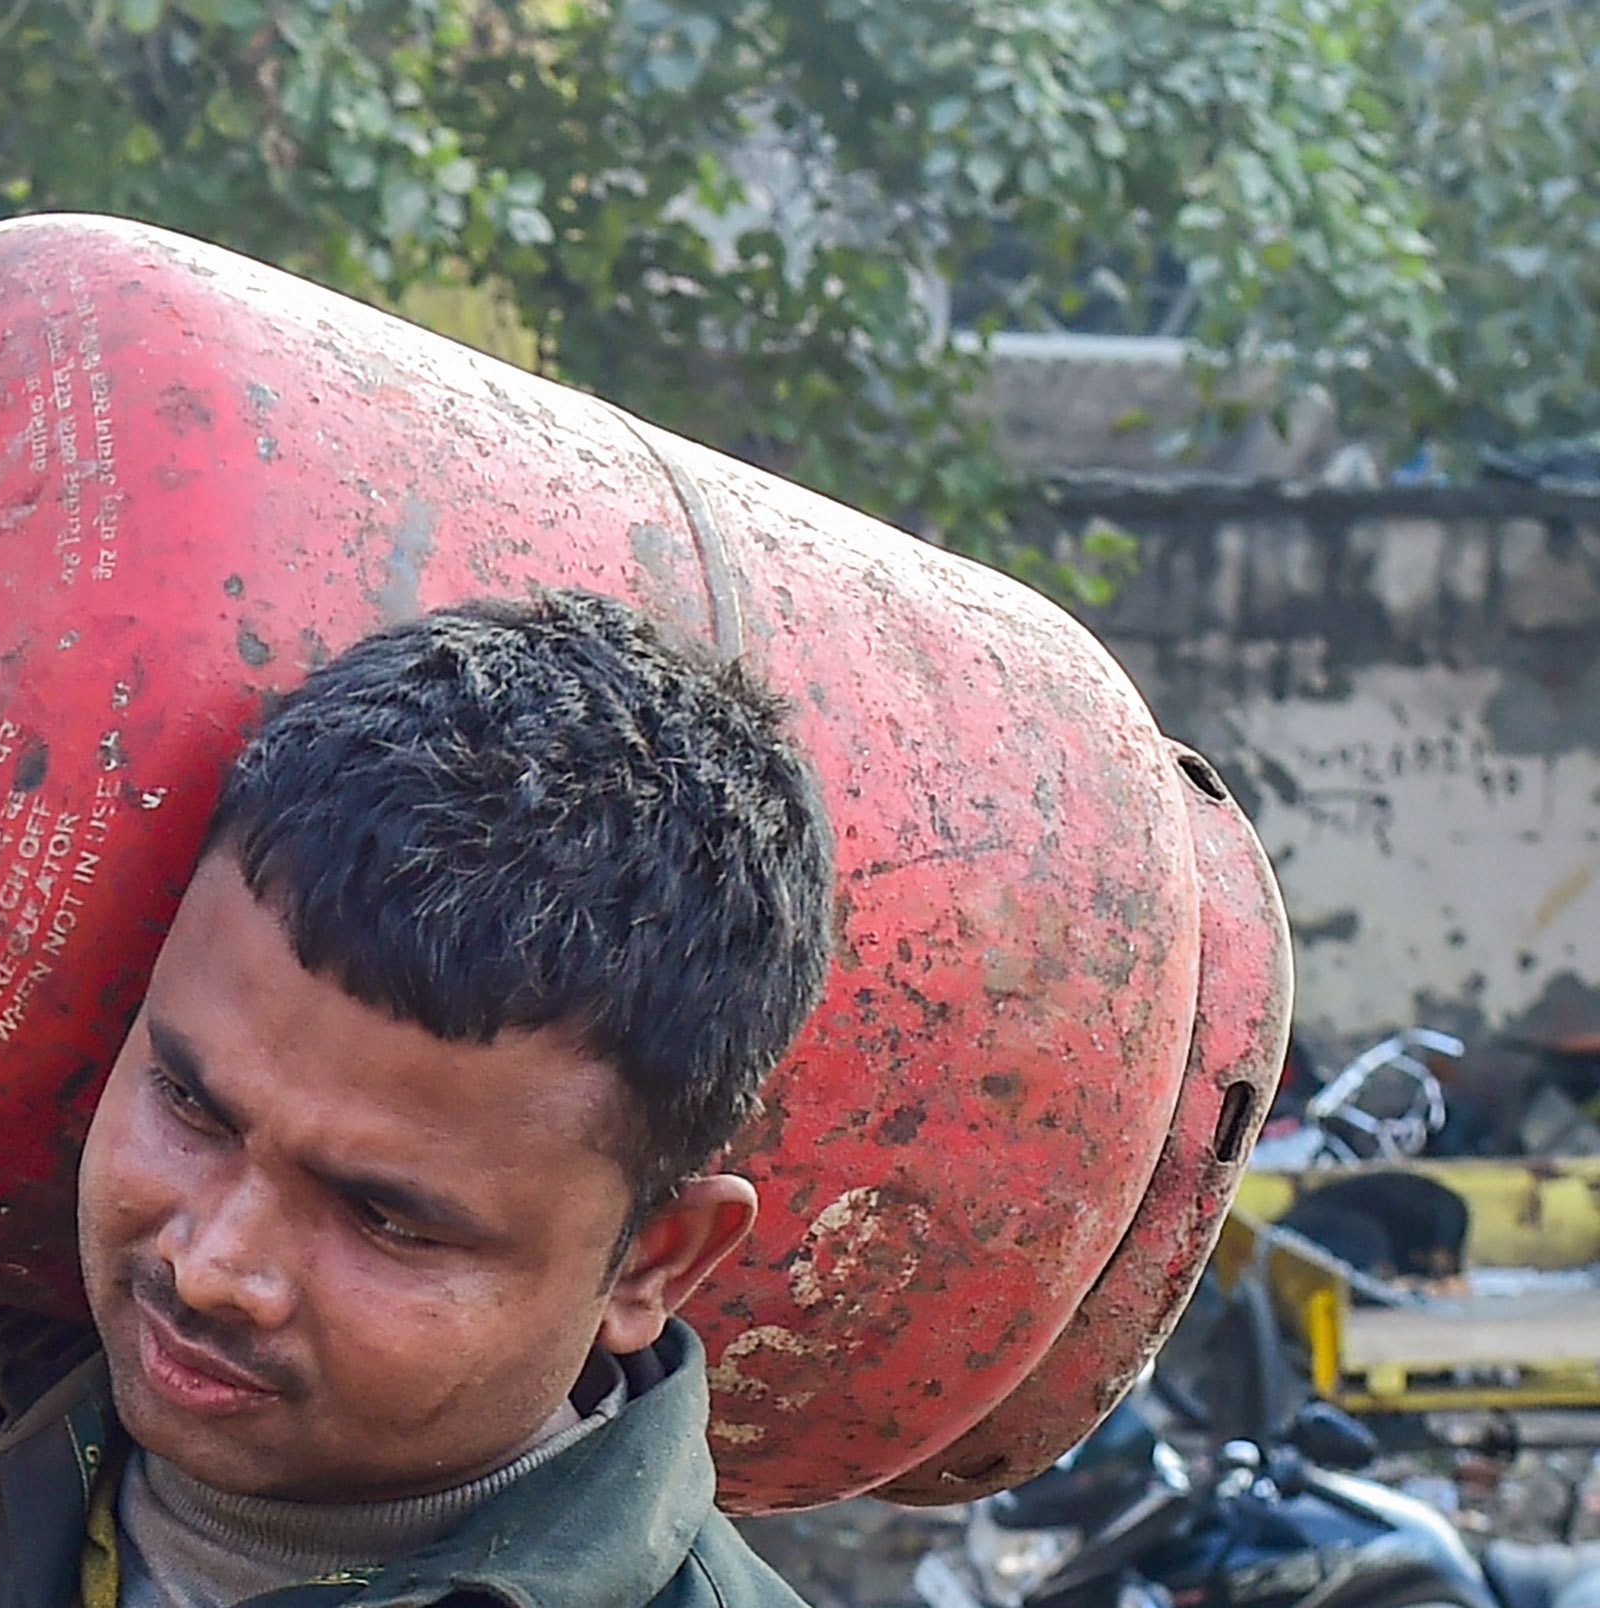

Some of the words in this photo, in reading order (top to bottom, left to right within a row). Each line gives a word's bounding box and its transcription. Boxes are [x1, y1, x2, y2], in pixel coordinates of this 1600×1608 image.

[18, 796, 51, 859] OFF
[43, 888, 83, 956] NOT
[73, 852, 99, 884] IN
